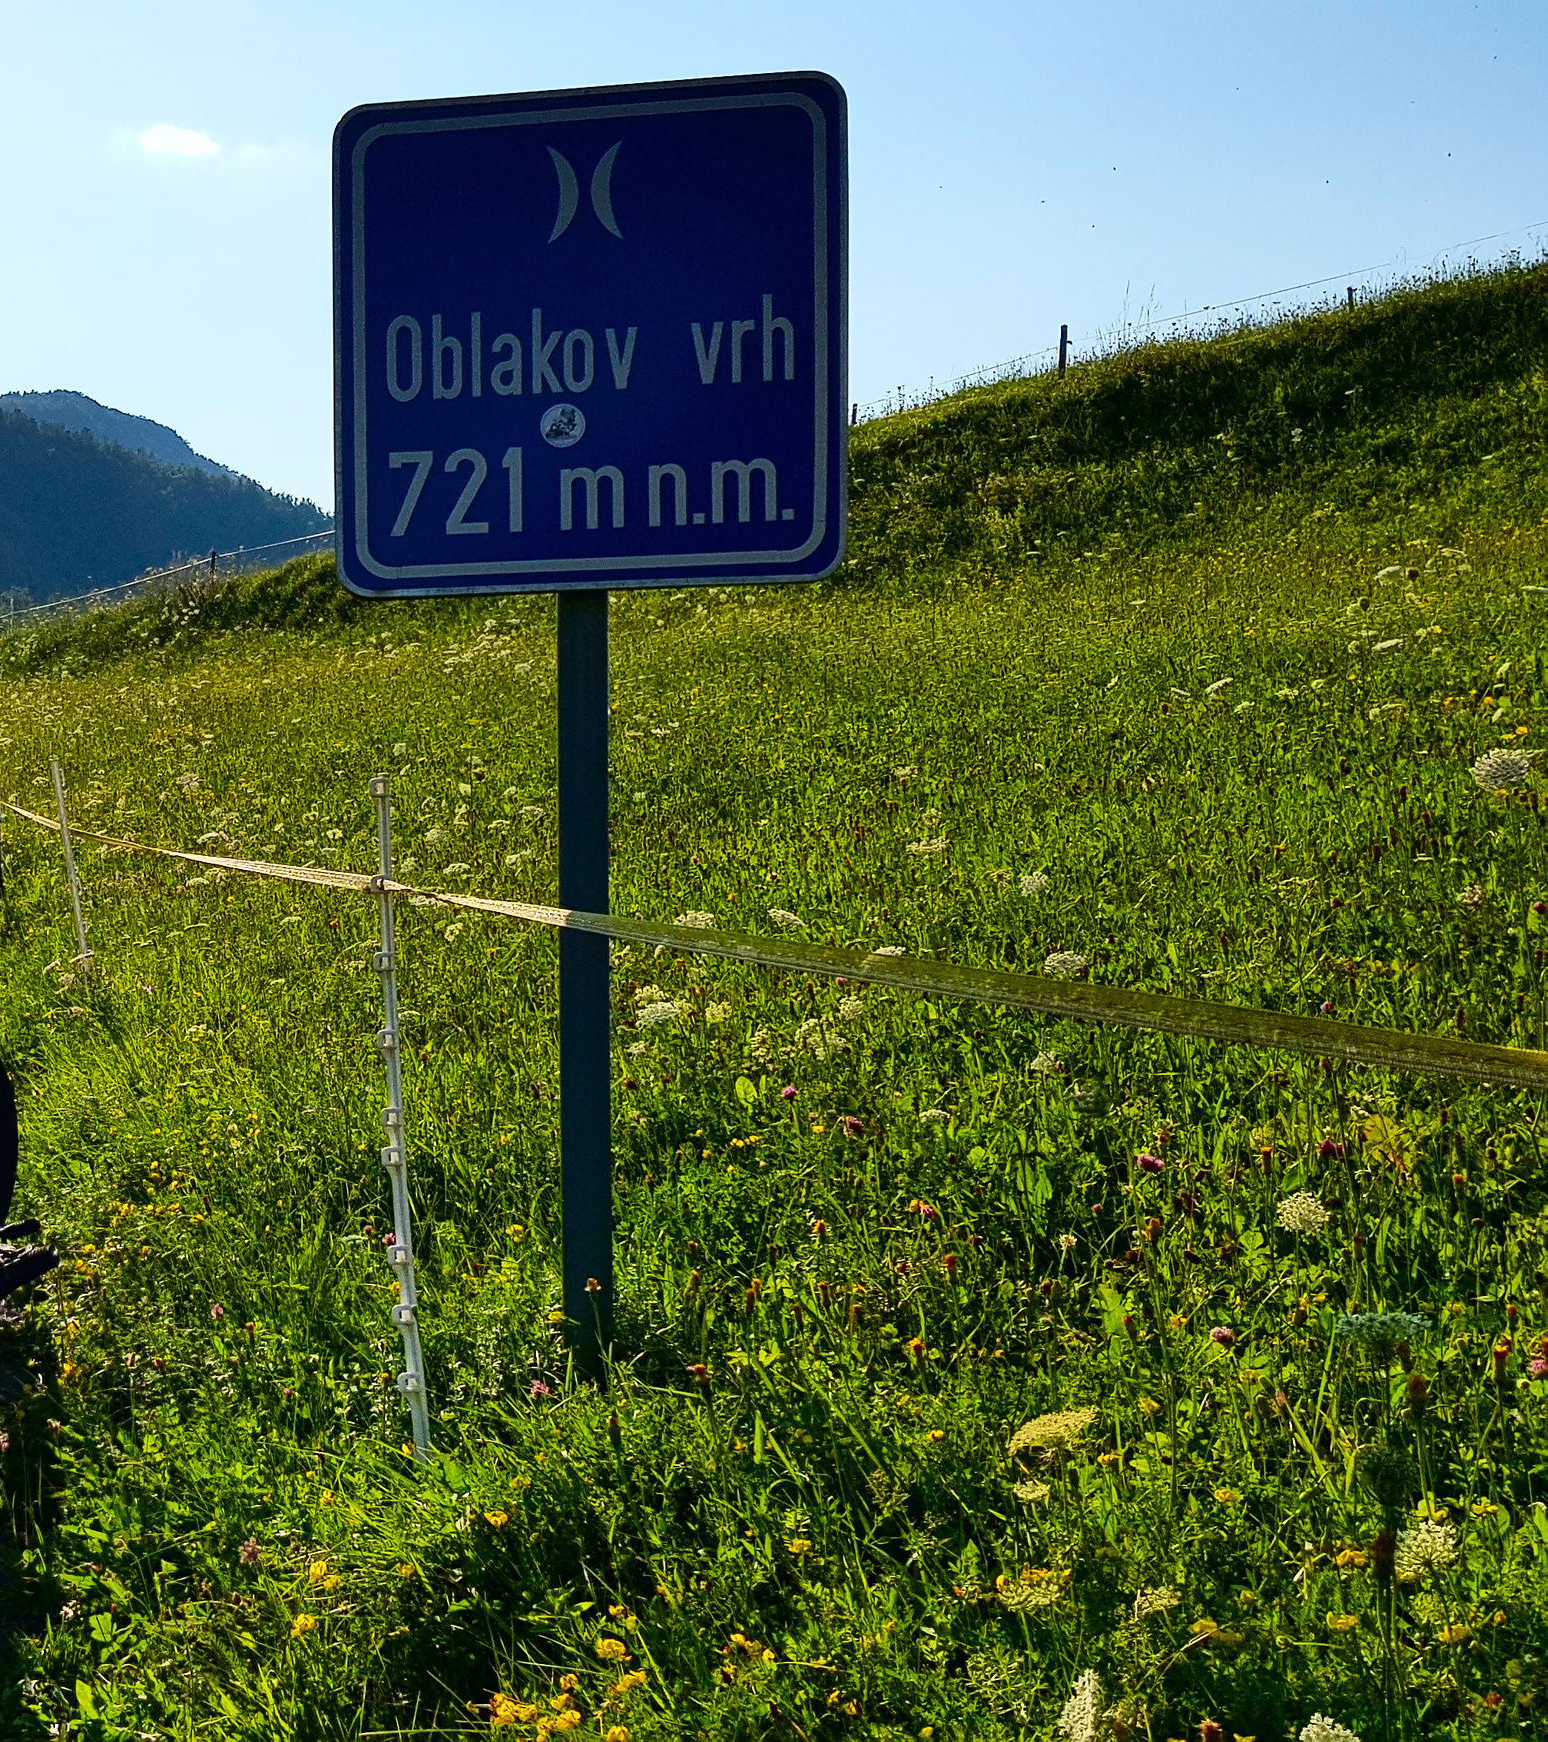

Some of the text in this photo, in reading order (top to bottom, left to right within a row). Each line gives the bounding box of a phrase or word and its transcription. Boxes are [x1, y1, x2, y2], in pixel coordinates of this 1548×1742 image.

[385, 293, 795, 402] Oblakov vrh
[388, 446, 795, 537] 721 m n.m.
